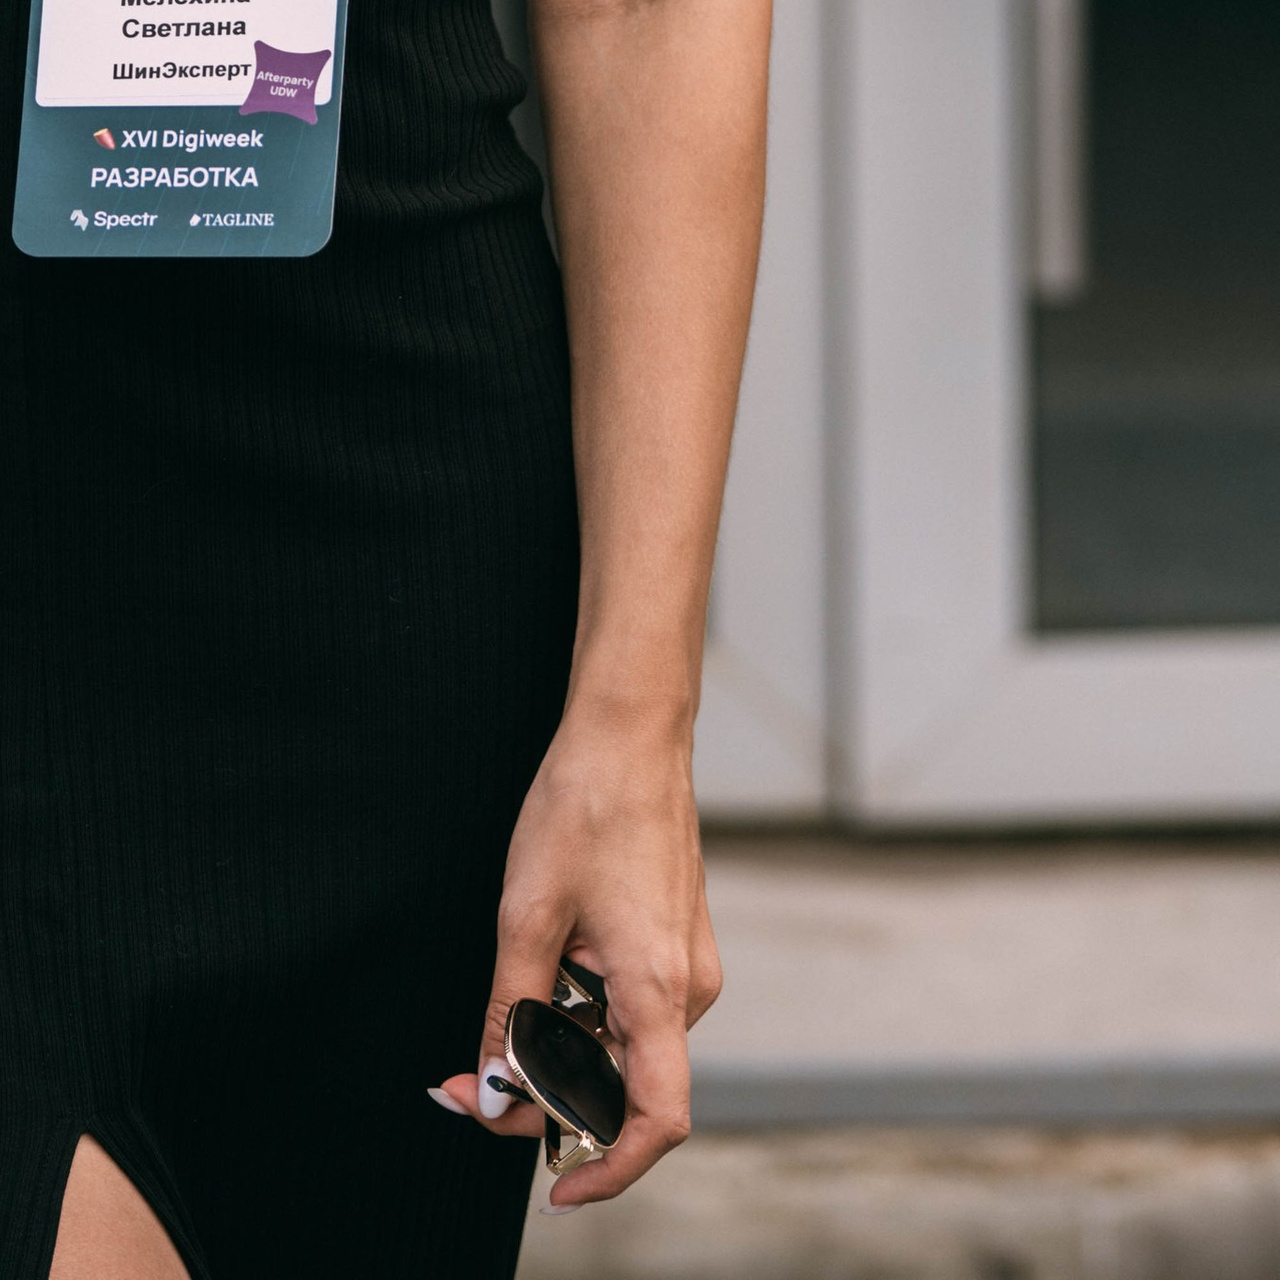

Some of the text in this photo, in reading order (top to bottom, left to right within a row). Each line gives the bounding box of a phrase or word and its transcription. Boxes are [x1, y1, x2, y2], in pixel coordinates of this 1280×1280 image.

[122, 19, 246, 38] Светлана
[113, 62, 252, 81] ШинЭксперт
[257, 71, 314, 89] Afterparty
[270, 86, 297, 98] UDW
[121, 130, 263, 153] XVI Digiweek
[91, 167, 258, 188] РАЗРАБОТКА
[94, 211, 158, 230] Spectr
[202, 213, 274, 227] TAGLINE
